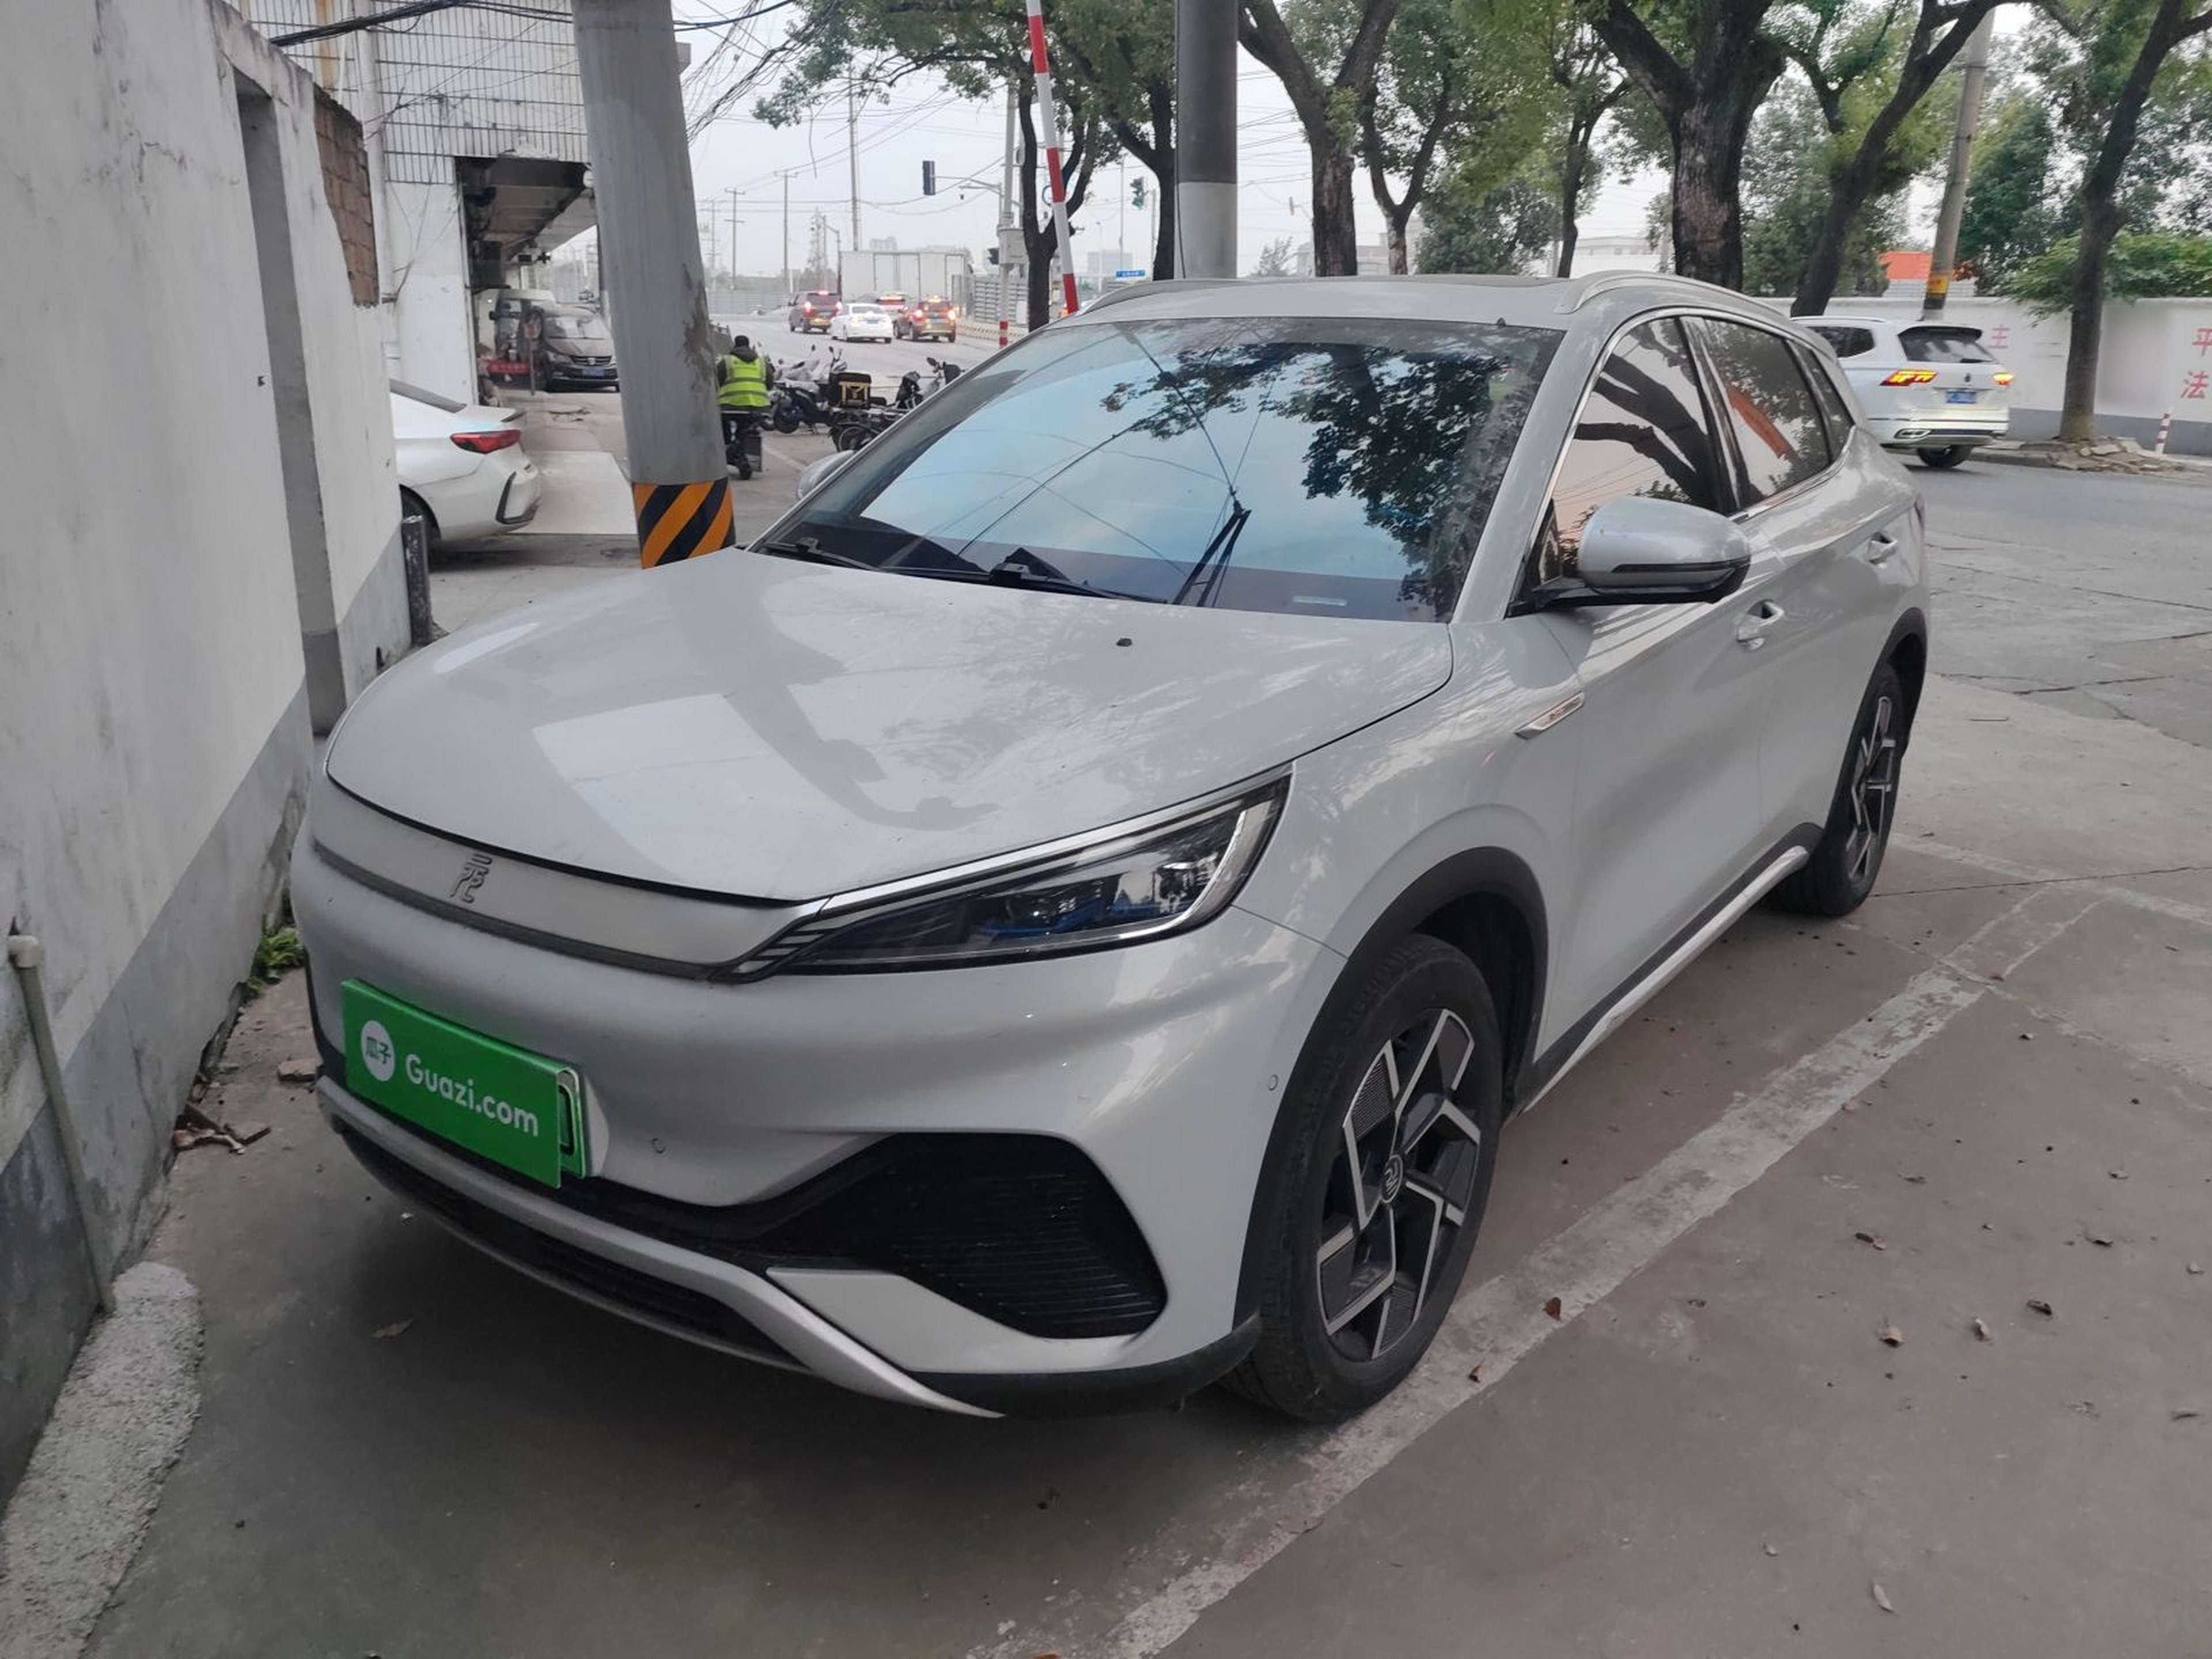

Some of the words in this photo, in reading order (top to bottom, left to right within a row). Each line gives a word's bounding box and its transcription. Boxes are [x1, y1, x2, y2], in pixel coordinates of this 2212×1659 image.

[2191, 328, 2212, 357] 平
[2180, 371, 2209, 399] 法
[365, 1036, 391, 1065] 瓜子
[406, 1054, 538, 1137] Guazi.com
